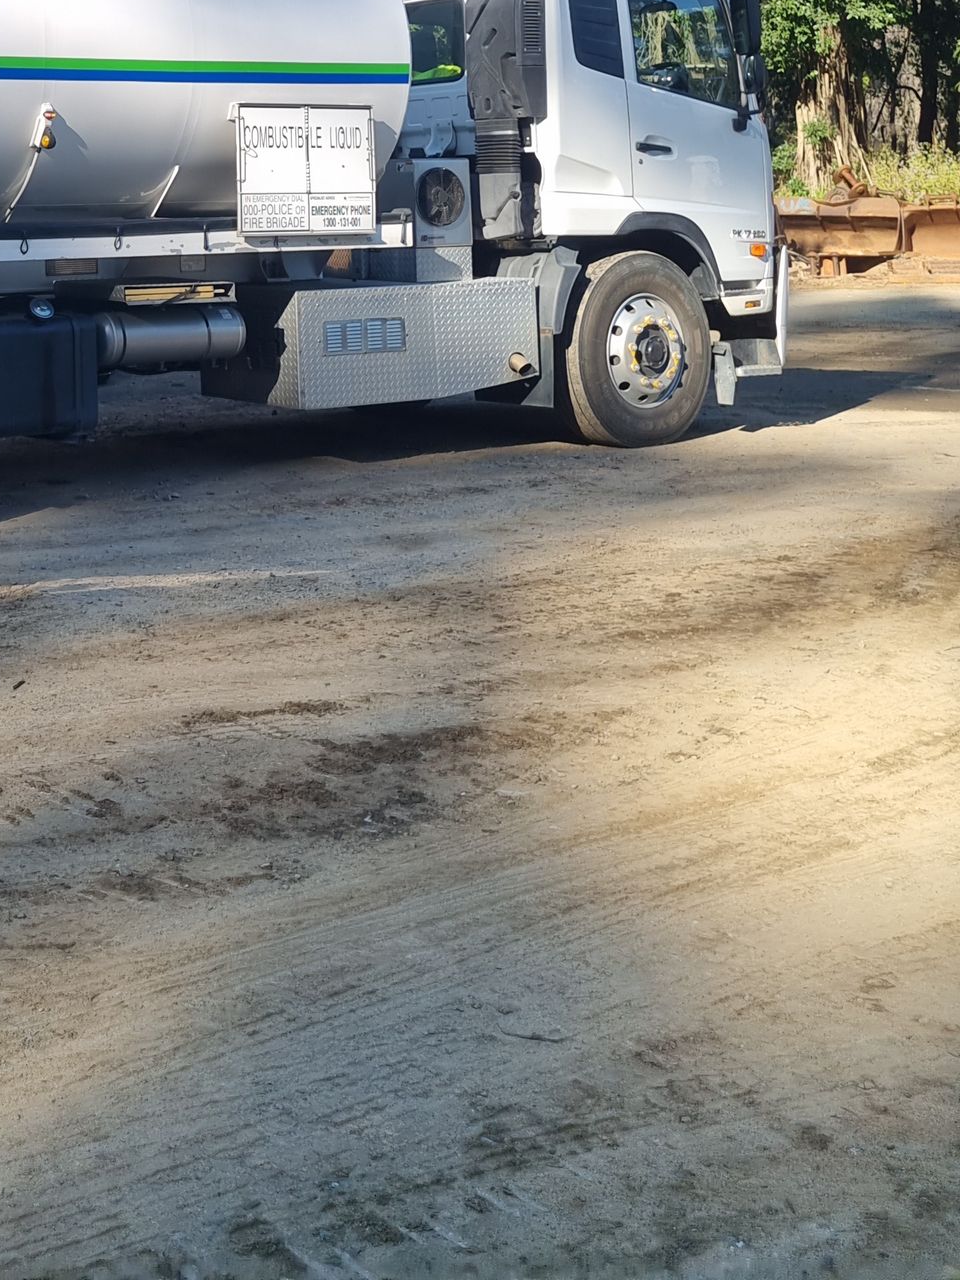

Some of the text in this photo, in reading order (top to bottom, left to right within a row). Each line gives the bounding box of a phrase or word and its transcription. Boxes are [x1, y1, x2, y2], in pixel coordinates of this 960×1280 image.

[243, 125, 362, 149] COMBUSTIBLE LIQUID
[244, 195, 252, 203] IN
[252, 194, 290, 203] EMERGENCY
[291, 194, 304, 203] DIAL
[295, 205, 306, 215] OR
[311, 205, 371, 216] EMERGENCY PHONE
[243, 216, 306, 229] FIRE BRIGADE
